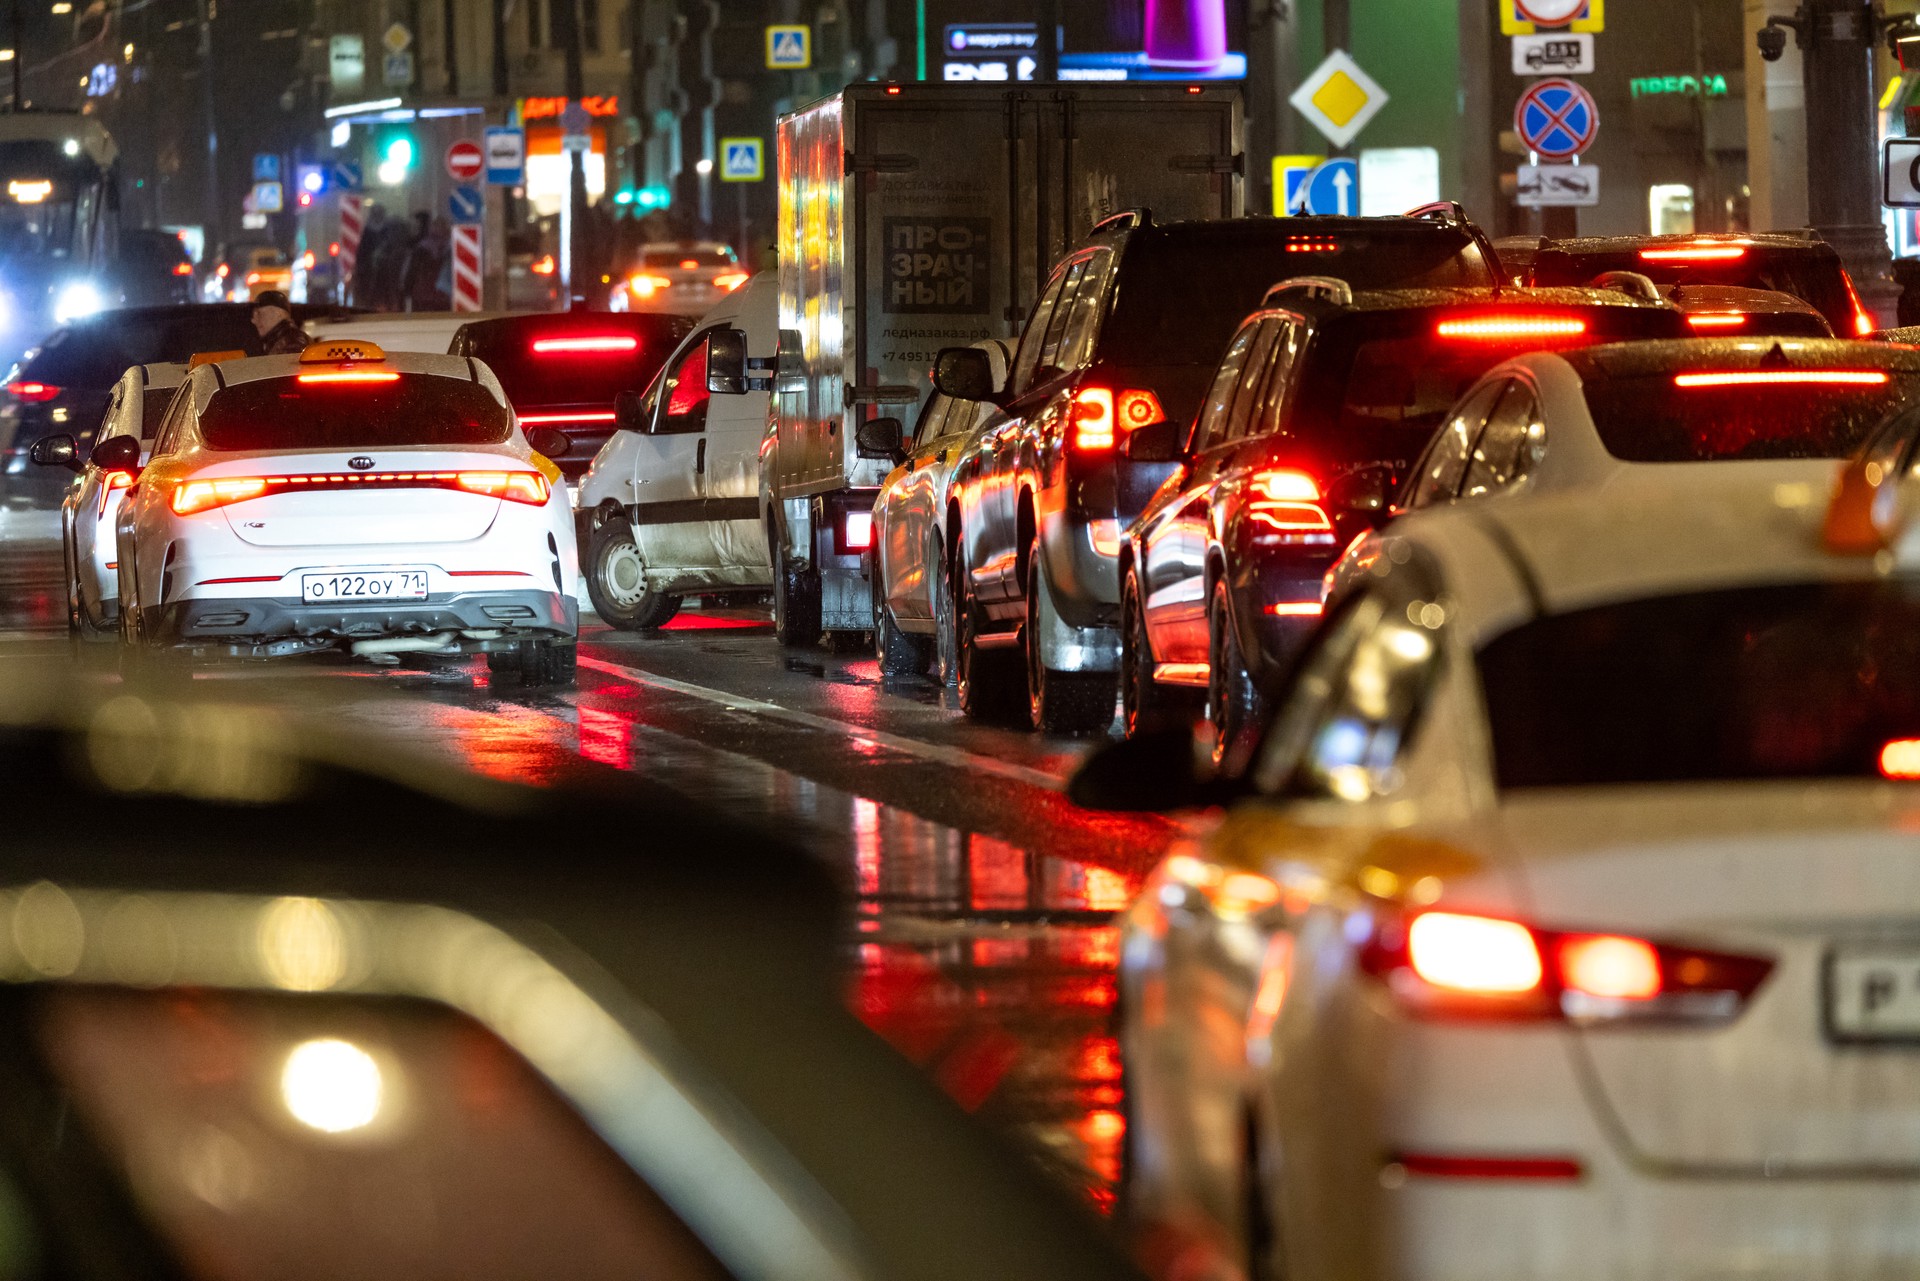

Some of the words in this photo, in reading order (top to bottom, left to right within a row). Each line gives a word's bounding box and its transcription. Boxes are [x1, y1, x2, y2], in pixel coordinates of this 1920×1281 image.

[892, 225, 987, 250] ПРО-
[891, 253, 987, 277] ЗРАЧ-
[892, 277, 974, 305] НЫЙ
[882, 327, 991, 340] ледназаказ.рф
[882, 351, 895, 362] +7
[898, 352, 923, 361] 495
[351, 457, 372, 468] KIA
